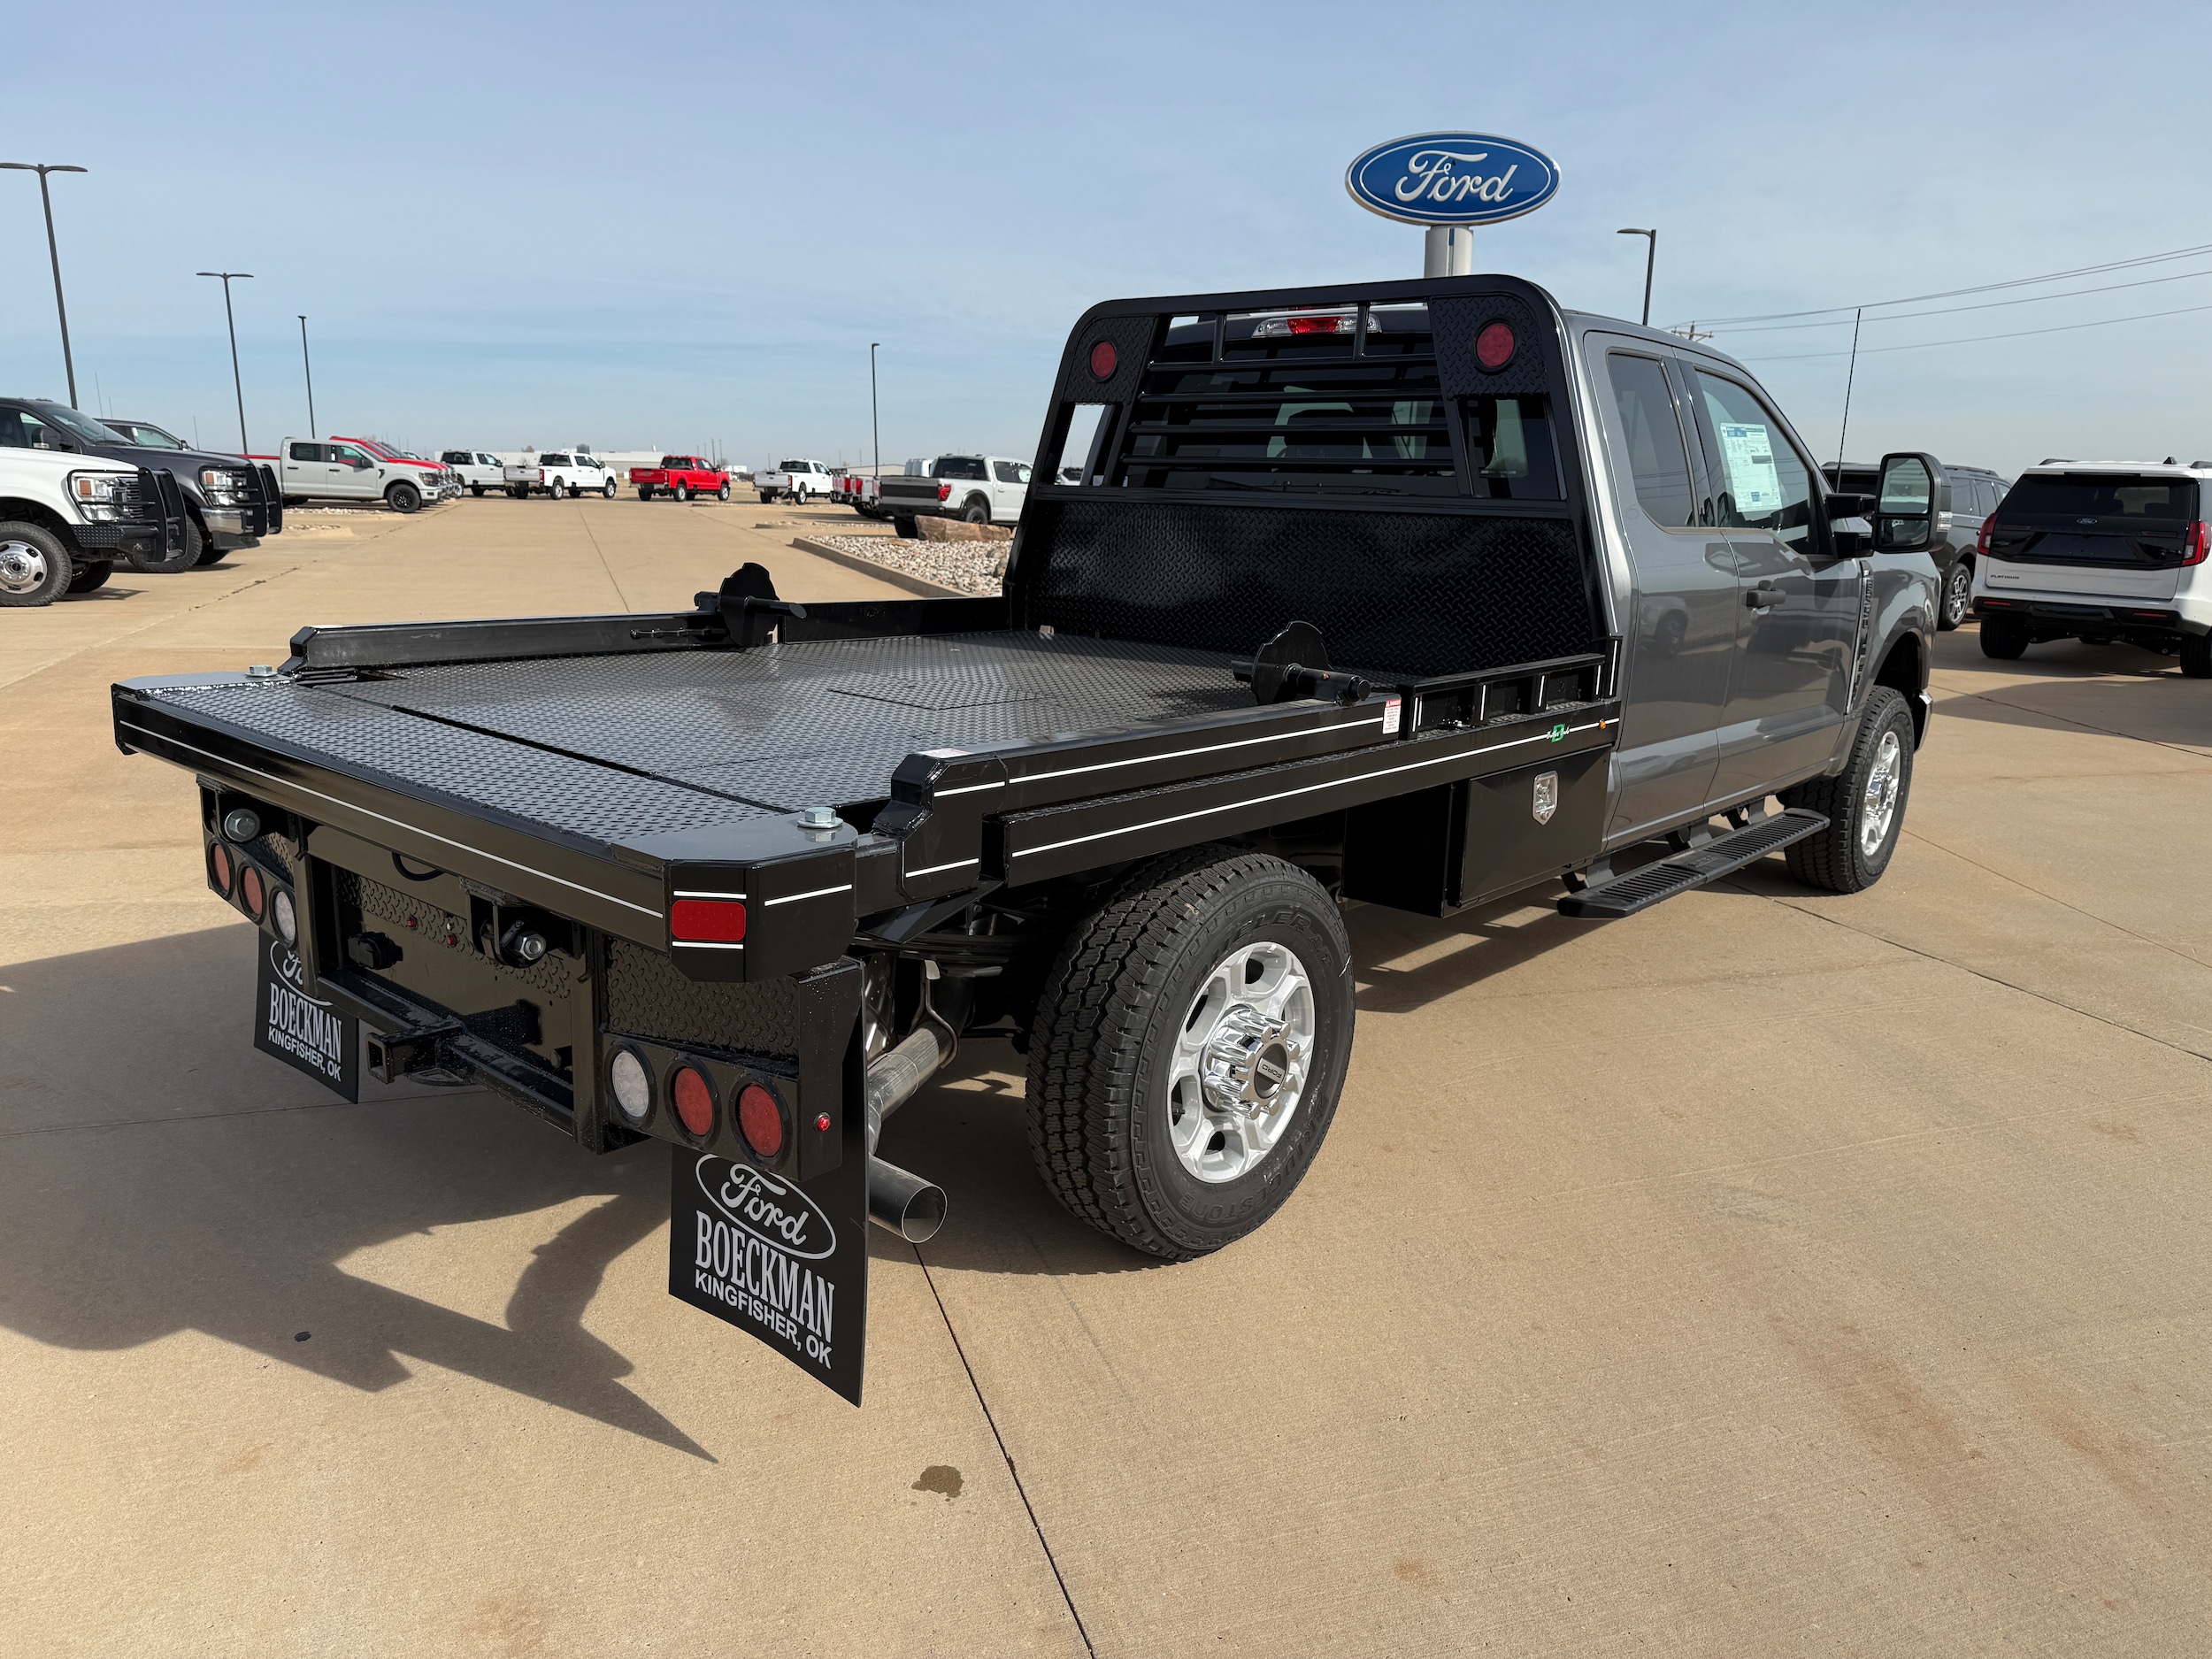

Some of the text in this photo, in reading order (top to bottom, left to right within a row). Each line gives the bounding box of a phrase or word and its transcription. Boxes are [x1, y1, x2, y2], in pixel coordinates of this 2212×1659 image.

[1394, 150, 1518, 203] Ford
[267, 1025, 342, 1082] KINGFISHER, OK
[268, 982, 342, 1064] BOECKMAN
[1262, 1064, 1282, 1079] FORD
[1179, 1092, 1330, 1224] BRIDGESTONE
[720, 1164, 809, 1246] Ford
[695, 1210, 834, 1343] BOECKMAN
[694, 1269, 832, 1370] KINGFISHER, OK
